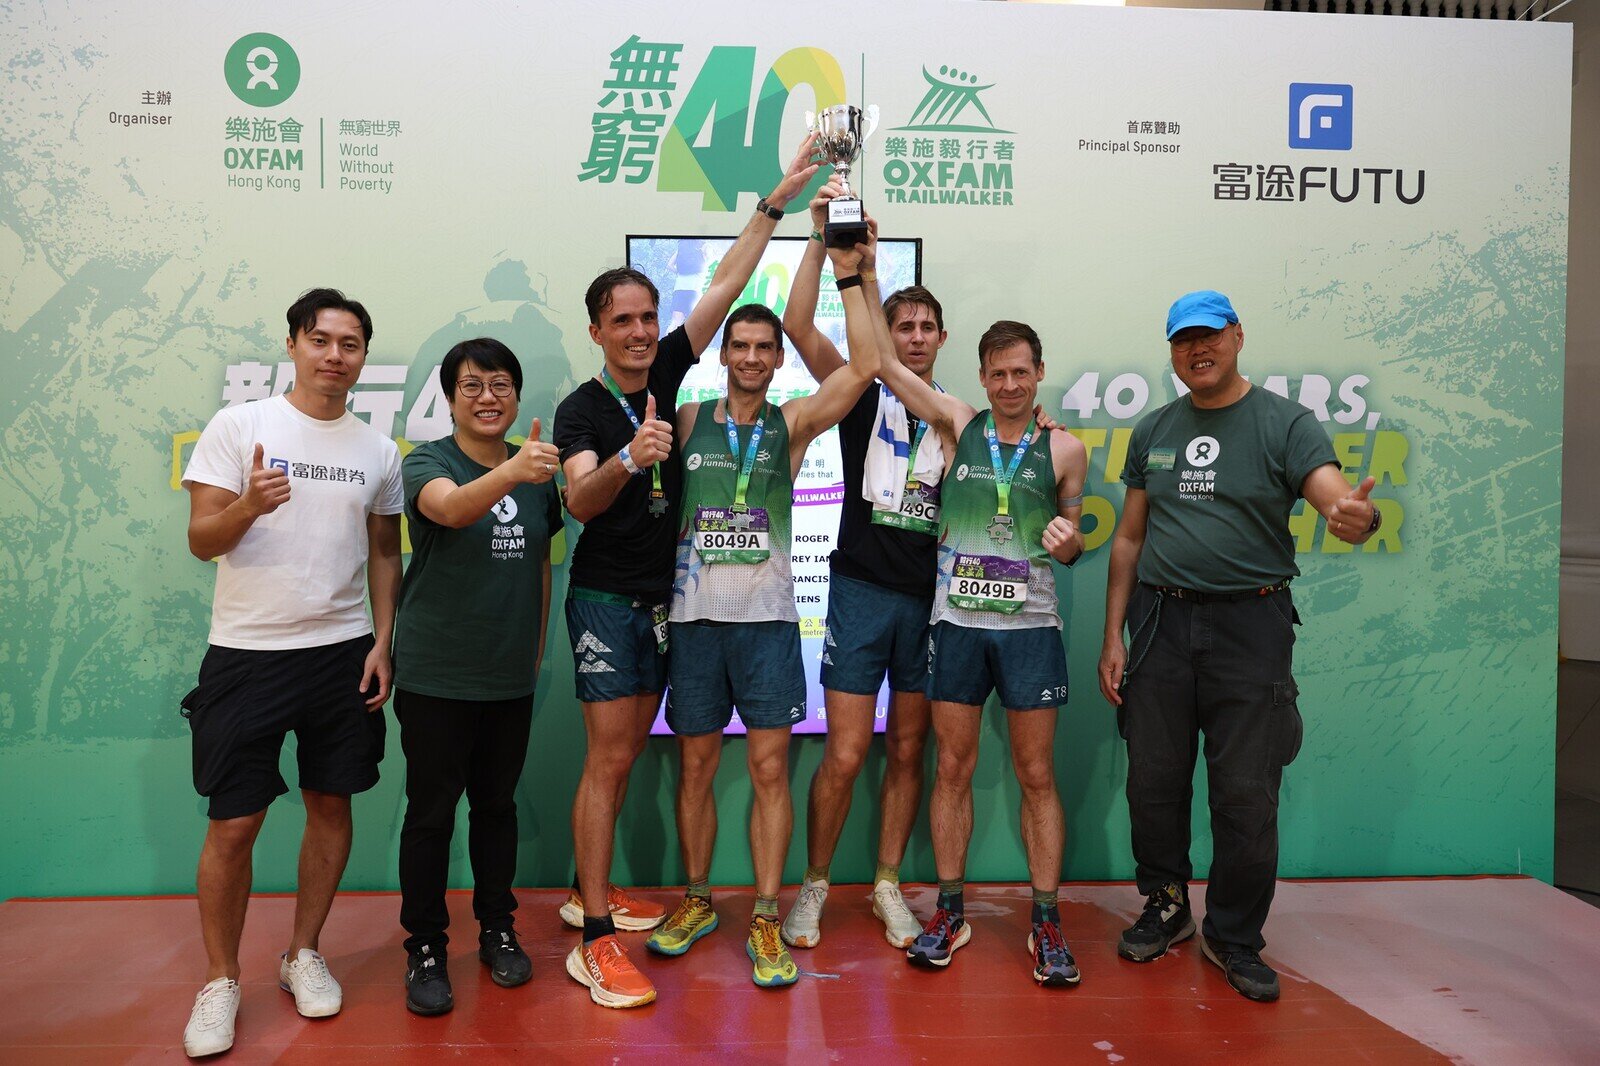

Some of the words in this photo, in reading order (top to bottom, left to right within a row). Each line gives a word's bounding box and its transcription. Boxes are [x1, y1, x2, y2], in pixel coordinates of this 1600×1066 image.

[141, 90, 172, 106] 主辦
[577, 34, 684, 185] 無窮
[109, 111, 172, 127] Organiser
[225, 116, 304, 143] 樂施會
[339, 119, 402, 137] 無窮世界
[656, 46, 846, 215] 40
[1127, 120, 1181, 134] 首席贊助
[340, 143, 378, 157] World
[885, 137, 1015, 161] 樂施毅行者
[1079, 139, 1130, 154] Principal
[1133, 140, 1181, 155] Sponsor
[223, 147, 304, 171] OXFAM
[340, 159, 394, 174] Without
[883, 161, 1013, 189] OXFAM
[227, 174, 263, 191] Hong
[267, 175, 301, 192] Kong
[340, 177, 392, 194] Poverty
[884, 188, 1014, 206] TRAILWALKER
[1062, 372, 1150, 419] 40
[292, 461, 366, 485] 富途證券
[702, 460, 738, 471] running
[968, 472, 996, 480] runnin
[1181, 469, 1217, 481] 樂施會
[1179, 482, 1215, 493] OXFAM
[794, 491, 844, 502] AILWALKE
[1180, 493, 1197, 501] Hong
[1198, 493, 1215, 501] Kong
[899, 503, 936, 520] 49C
[492, 524, 525, 538] 樂施會
[491, 538, 526, 550] OXFAM
[703, 534, 760, 549] 8049A
[795, 535, 830, 543] ROGER
[492, 551, 507, 561] Hong
[508, 551, 524, 560] Kong
[792, 555, 811, 563] REY
[793, 575, 829, 583] RANCIS
[958, 580, 1016, 599] 8049B
[794, 595, 821, 603] IENS
[1054, 685, 1067, 699] T8
[585, 948, 605, 986] TERREX
